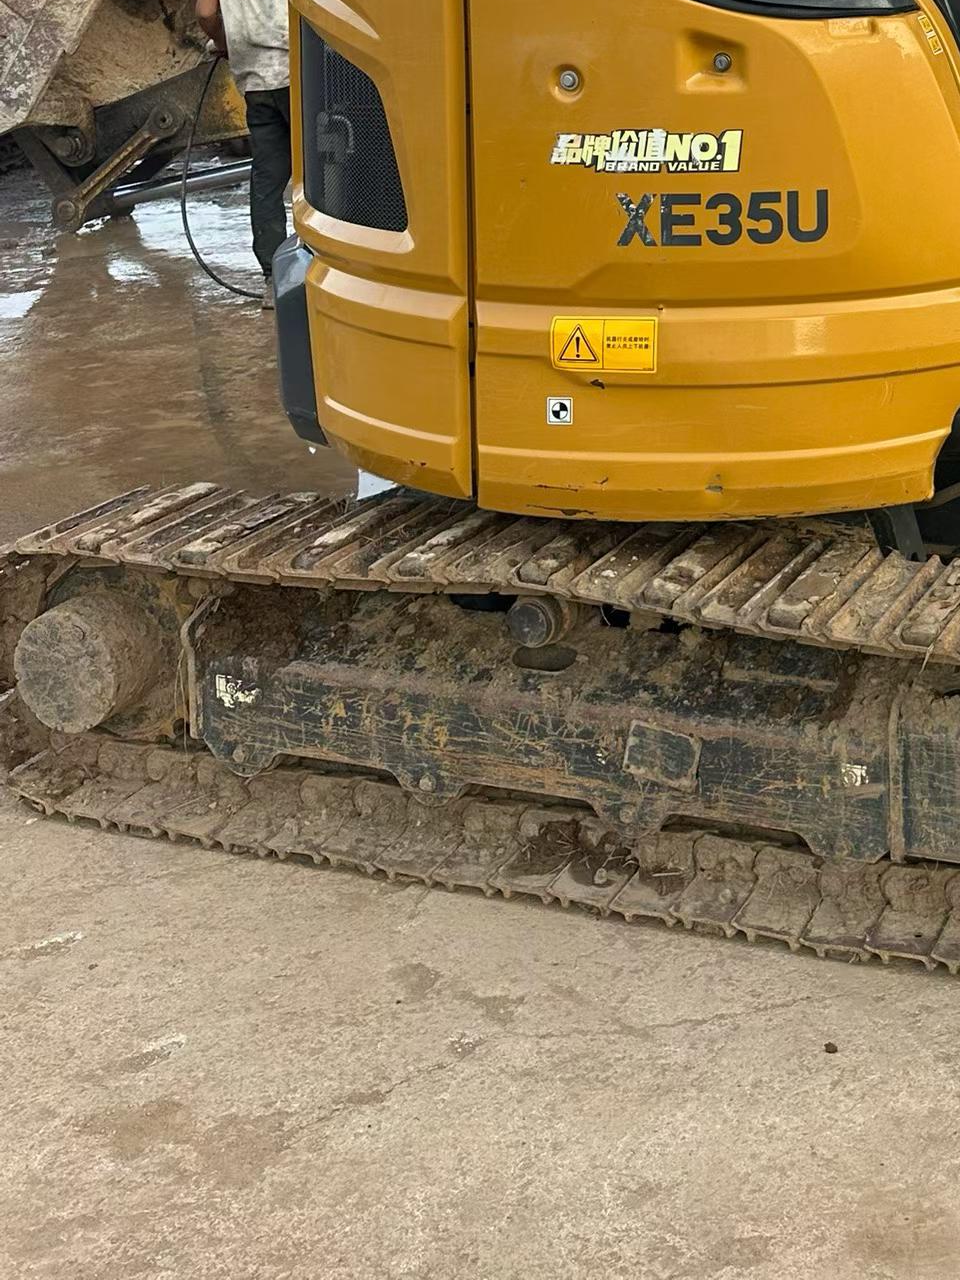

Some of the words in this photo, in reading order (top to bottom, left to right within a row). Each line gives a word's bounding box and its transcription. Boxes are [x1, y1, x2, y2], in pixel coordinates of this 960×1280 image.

[605, 161, 660, 172] BRAND
[668, 161, 720, 172] VALUE
[616, 189, 829, 247] XE35U
